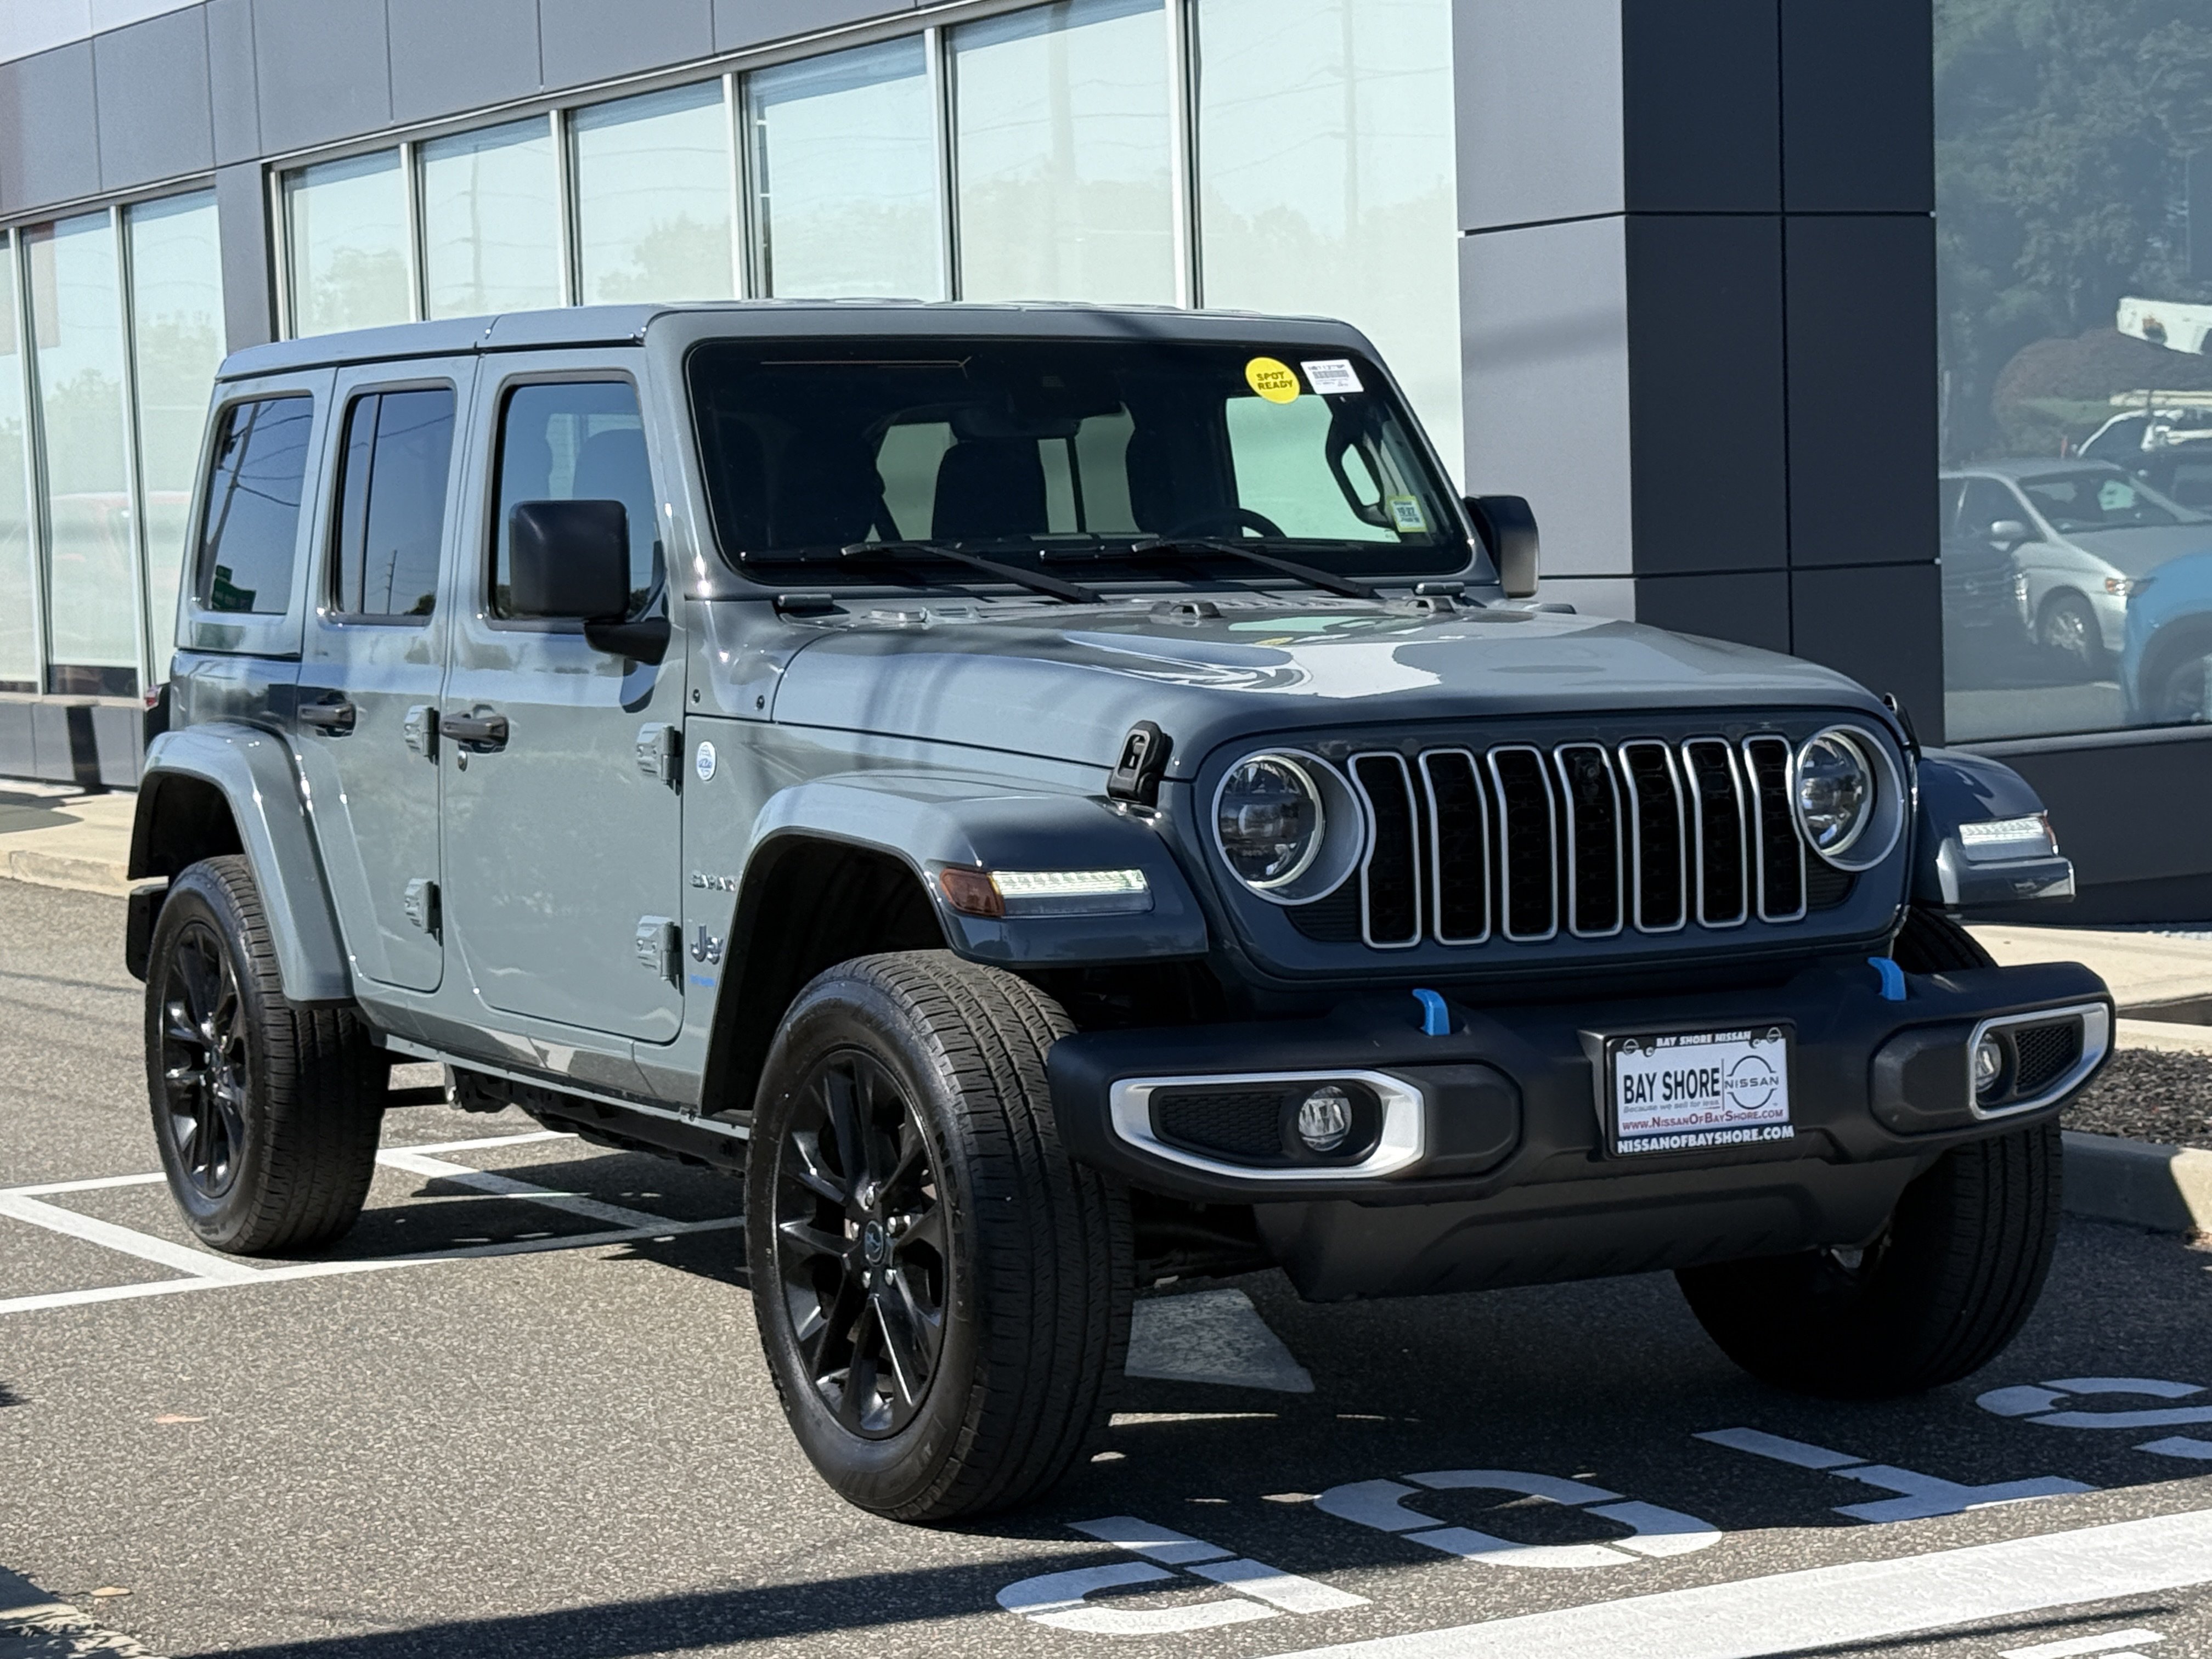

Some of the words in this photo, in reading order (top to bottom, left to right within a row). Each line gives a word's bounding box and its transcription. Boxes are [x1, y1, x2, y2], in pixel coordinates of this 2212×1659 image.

[1256, 371, 1285, 381] SPOT
[1257, 379, 1294, 390] READY
[1656, 1037, 1676, 1047] BAY
[1679, 1034, 1712, 1046] SHORE
[1715, 1030, 1751, 1042] NISSAN
[1623, 1071, 1657, 1104] BAY
[1662, 1067, 1721, 1101] SHORE
[1724, 1076, 1779, 1090] NISSAN
[1623, 1104, 1658, 1114] Because
[1690, 1099, 1701, 1108] for
[1617, 1124, 1795, 1154] NISSANOFBAYSHORE.COM
